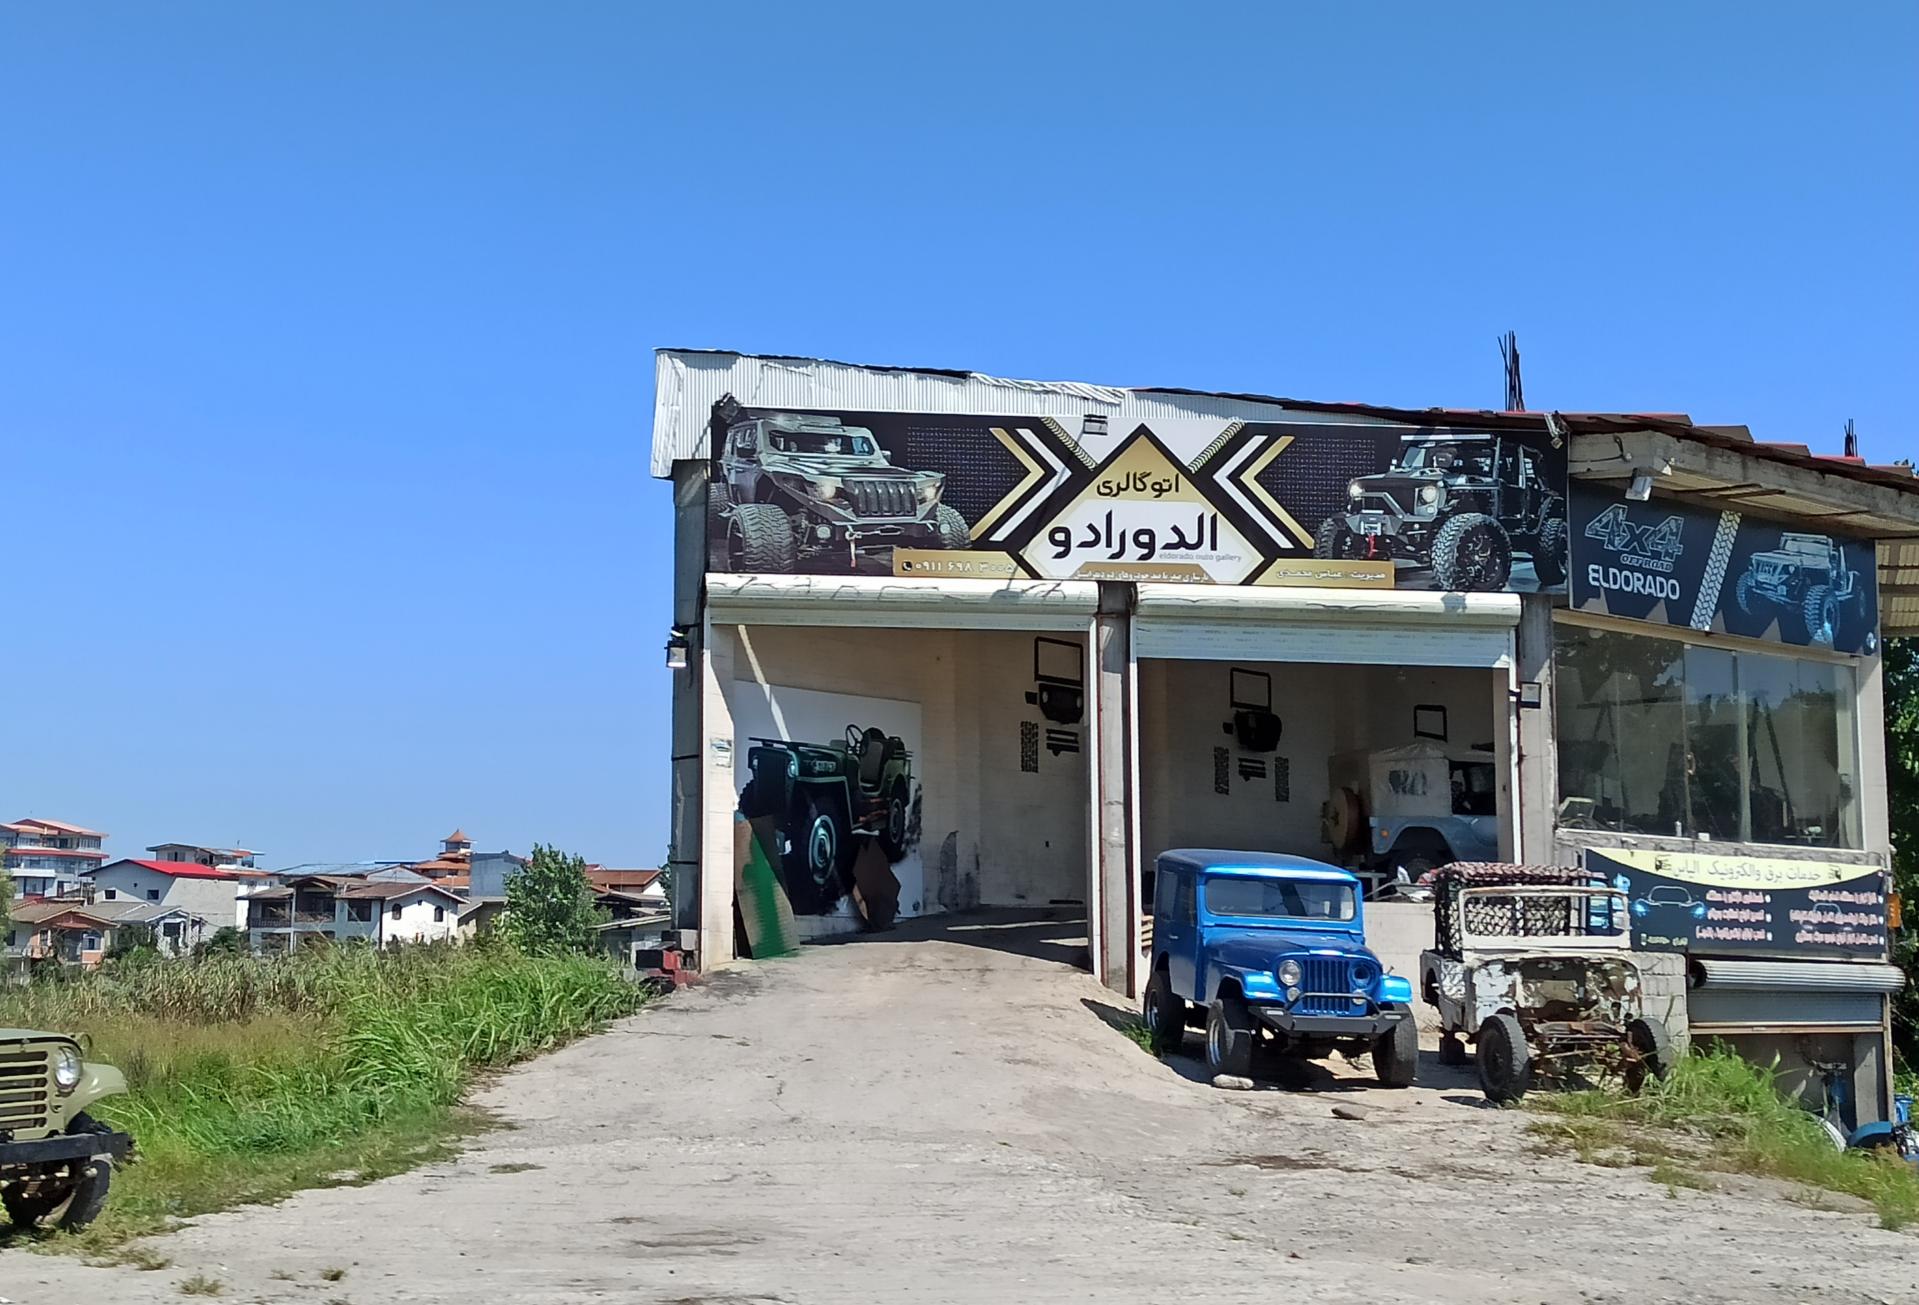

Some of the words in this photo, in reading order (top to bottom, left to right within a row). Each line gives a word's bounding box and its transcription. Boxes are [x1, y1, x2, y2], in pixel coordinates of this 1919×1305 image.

[1048, 509, 1218, 561] الدورادو
[1159, 552, 1194, 560] eldorado
[1215, 554, 1242, 563] gallery
[1587, 564, 1680, 600] ELDORADO
